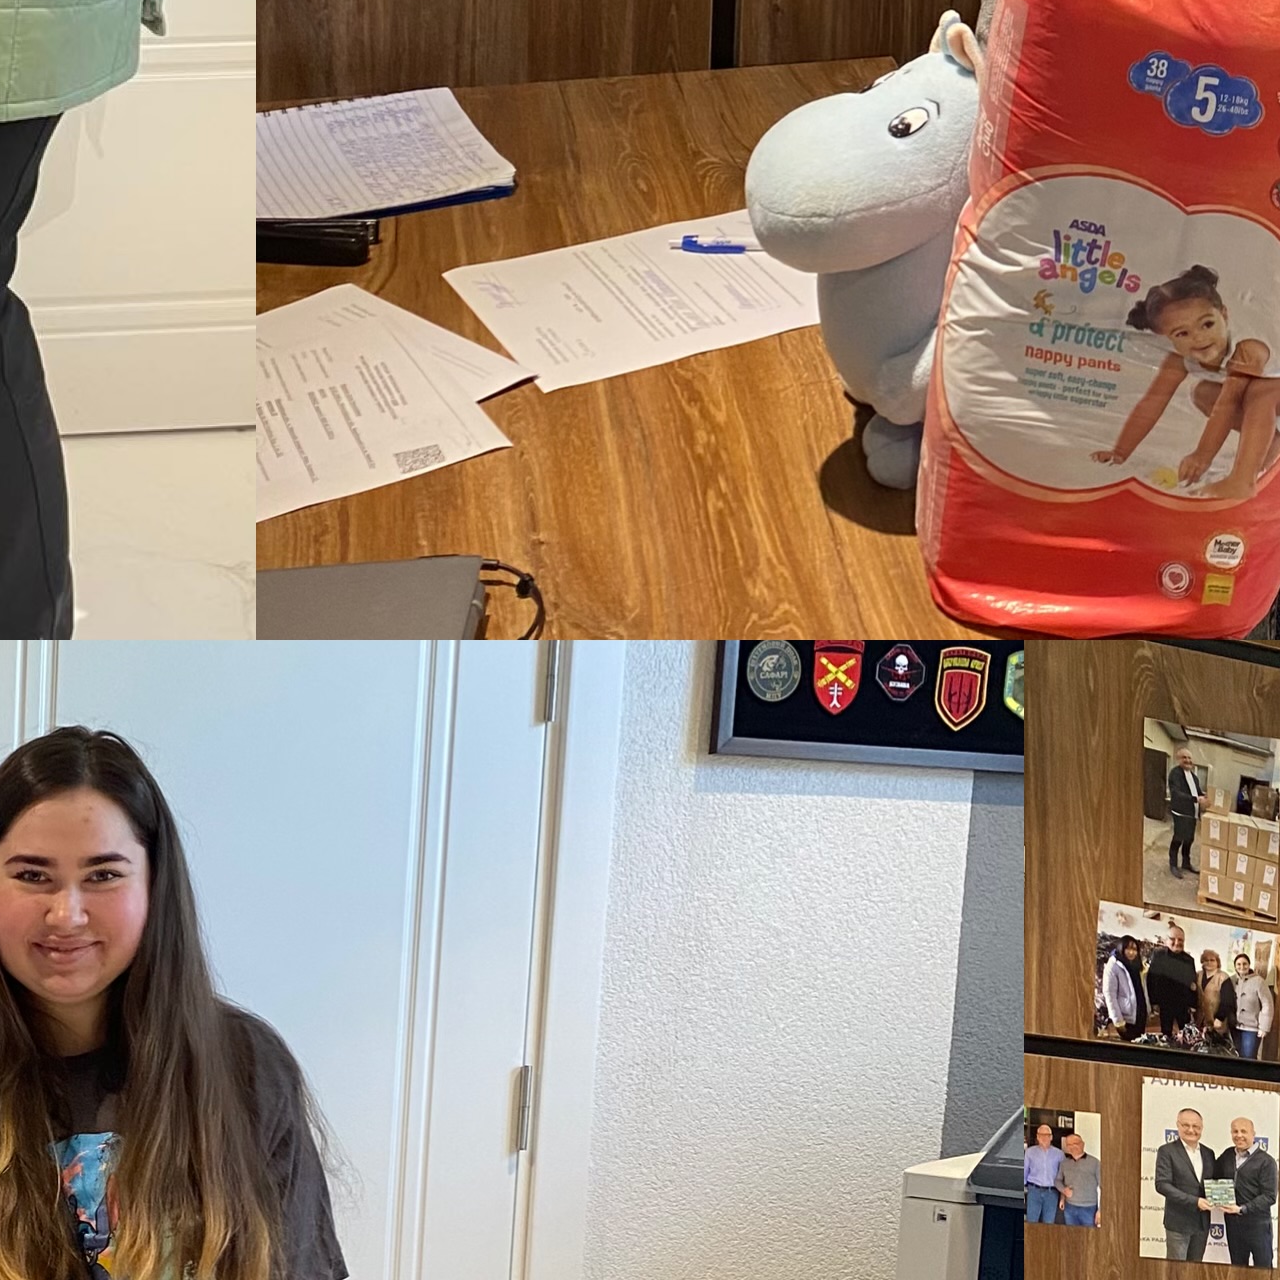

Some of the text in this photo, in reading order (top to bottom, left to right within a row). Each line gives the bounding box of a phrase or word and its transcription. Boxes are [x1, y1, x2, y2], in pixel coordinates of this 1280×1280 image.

[1147, 58, 1168, 78] 38
[1191, 76, 1219, 123] 5
[1069, 219, 1106, 236] ASDA
[1053, 230, 1125, 269] little
[1038, 258, 1141, 293] angels
[1051, 320, 1126, 352] protect
[1025, 345, 1121, 372] nappy pants
